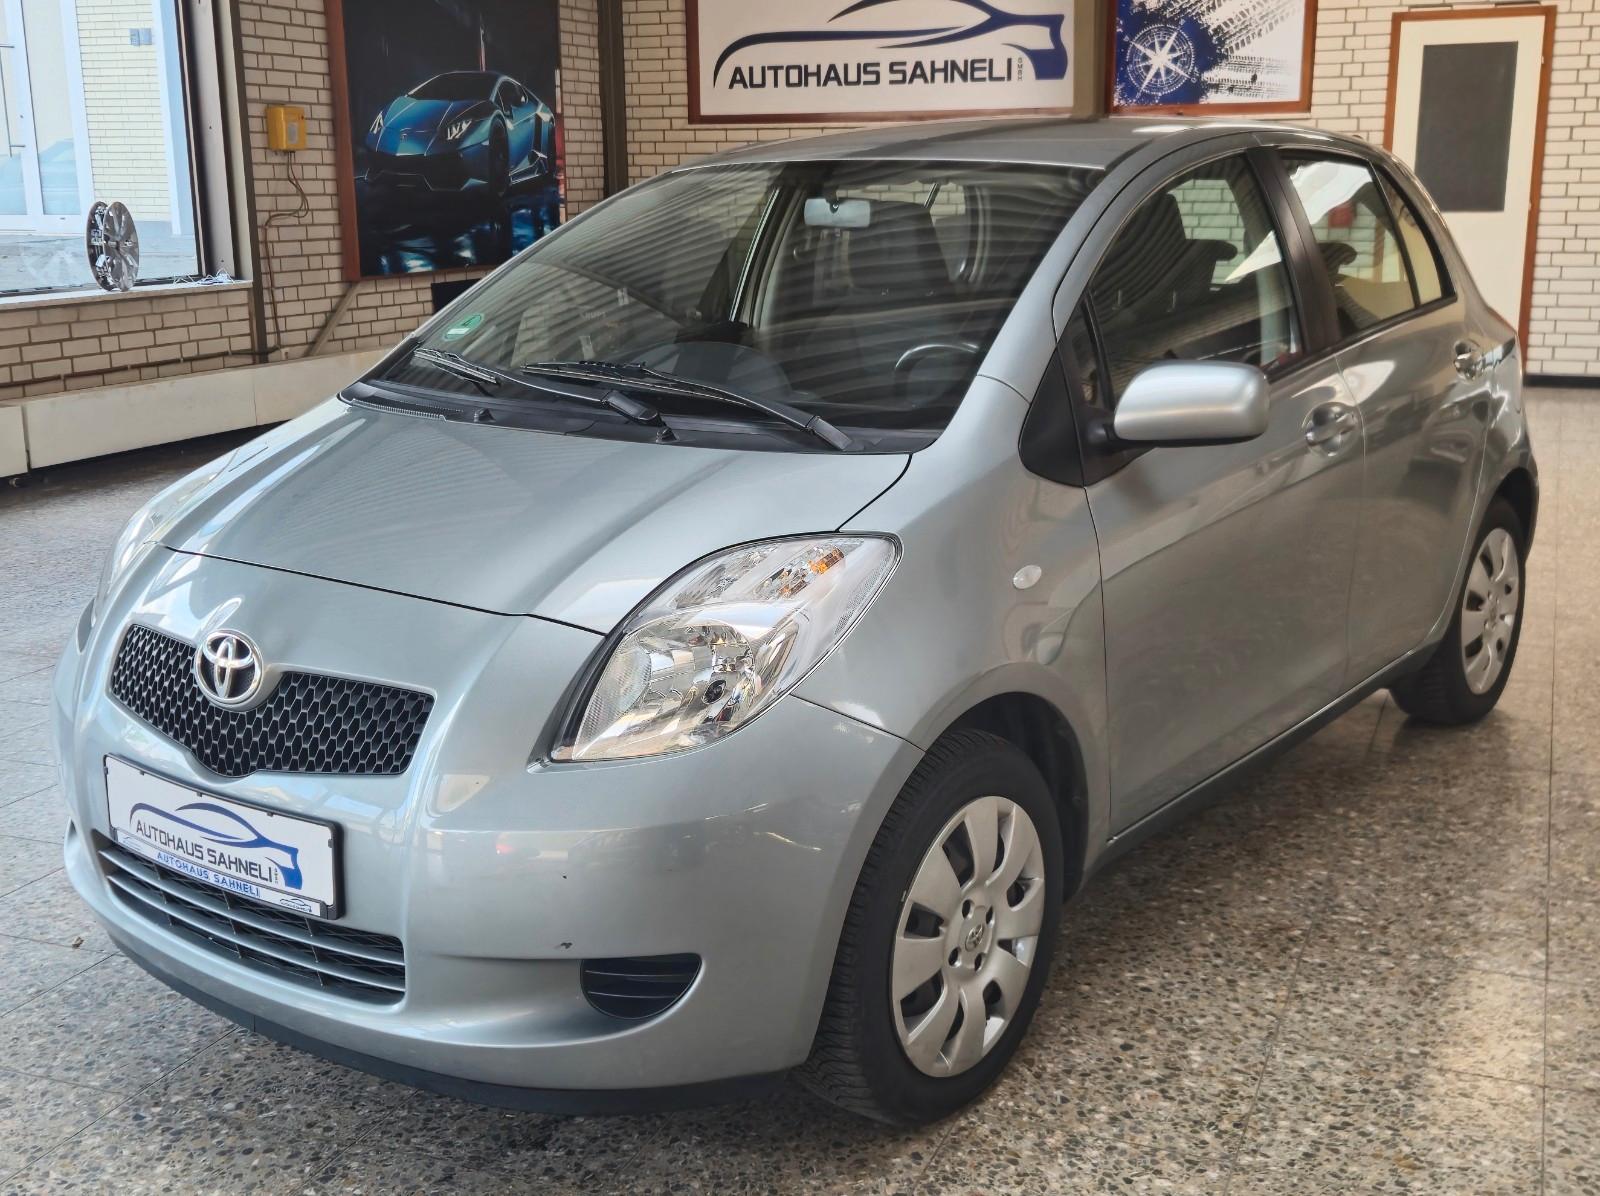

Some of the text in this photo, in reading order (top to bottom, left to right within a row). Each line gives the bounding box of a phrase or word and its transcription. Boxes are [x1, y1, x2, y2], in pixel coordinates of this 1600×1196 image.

[728, 57, 1012, 90] AUTOHAUS SAHNELI
[136, 820, 204, 860] AUTOHAUS
[207, 848, 272, 883] SAHNELI
[157, 851, 209, 879] AUTOHAUS
[213, 873, 260, 897] SAHNELI
